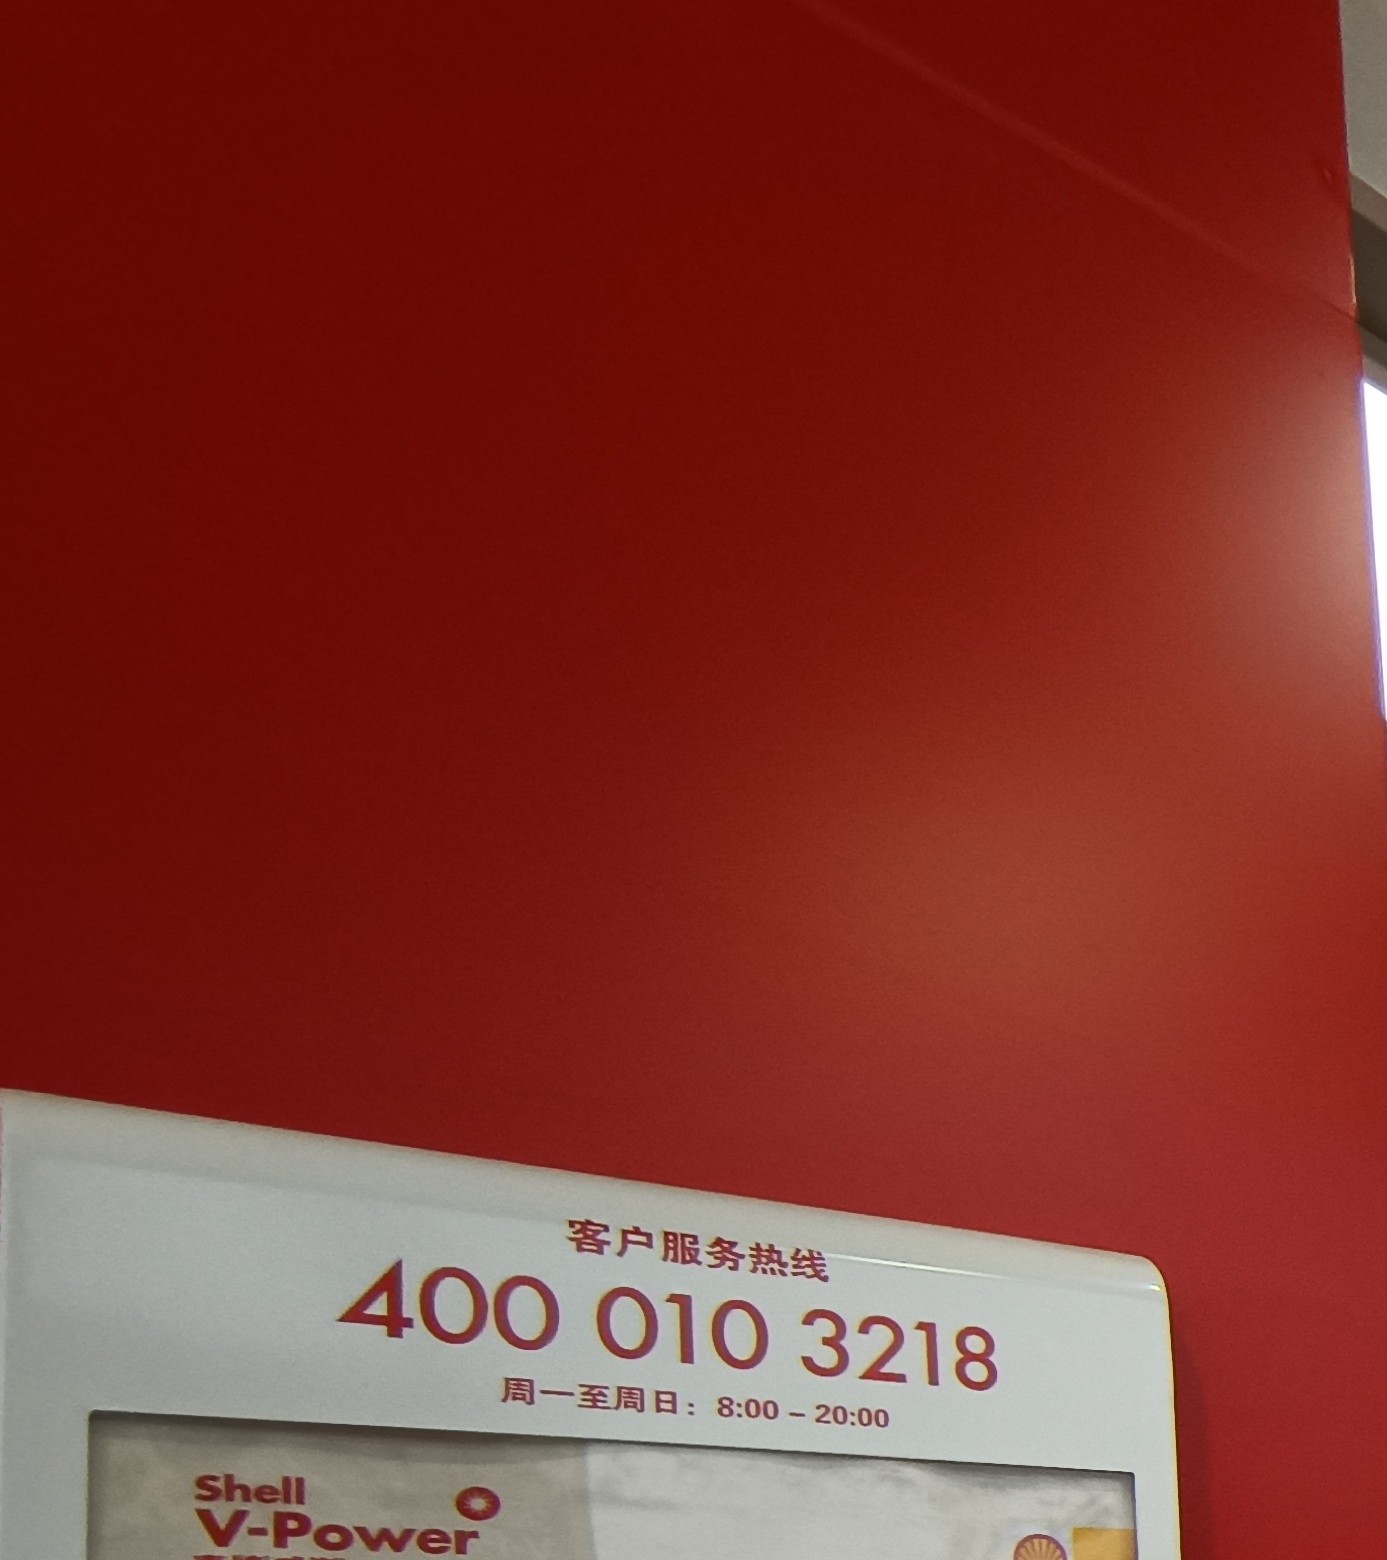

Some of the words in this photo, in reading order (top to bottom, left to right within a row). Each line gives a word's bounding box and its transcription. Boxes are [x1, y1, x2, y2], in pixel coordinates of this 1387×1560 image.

[566, 1217, 830, 1284] 客户服务热线
[336, 1259, 561, 1352] 400
[597, 1286, 771, 1371] 010
[801, 1310, 1000, 1393] 3218
[814, 1404, 891, 1430] 20:00
[195, 1474, 306, 1506] Shell
[195, 1508, 480, 1555] V-Power
